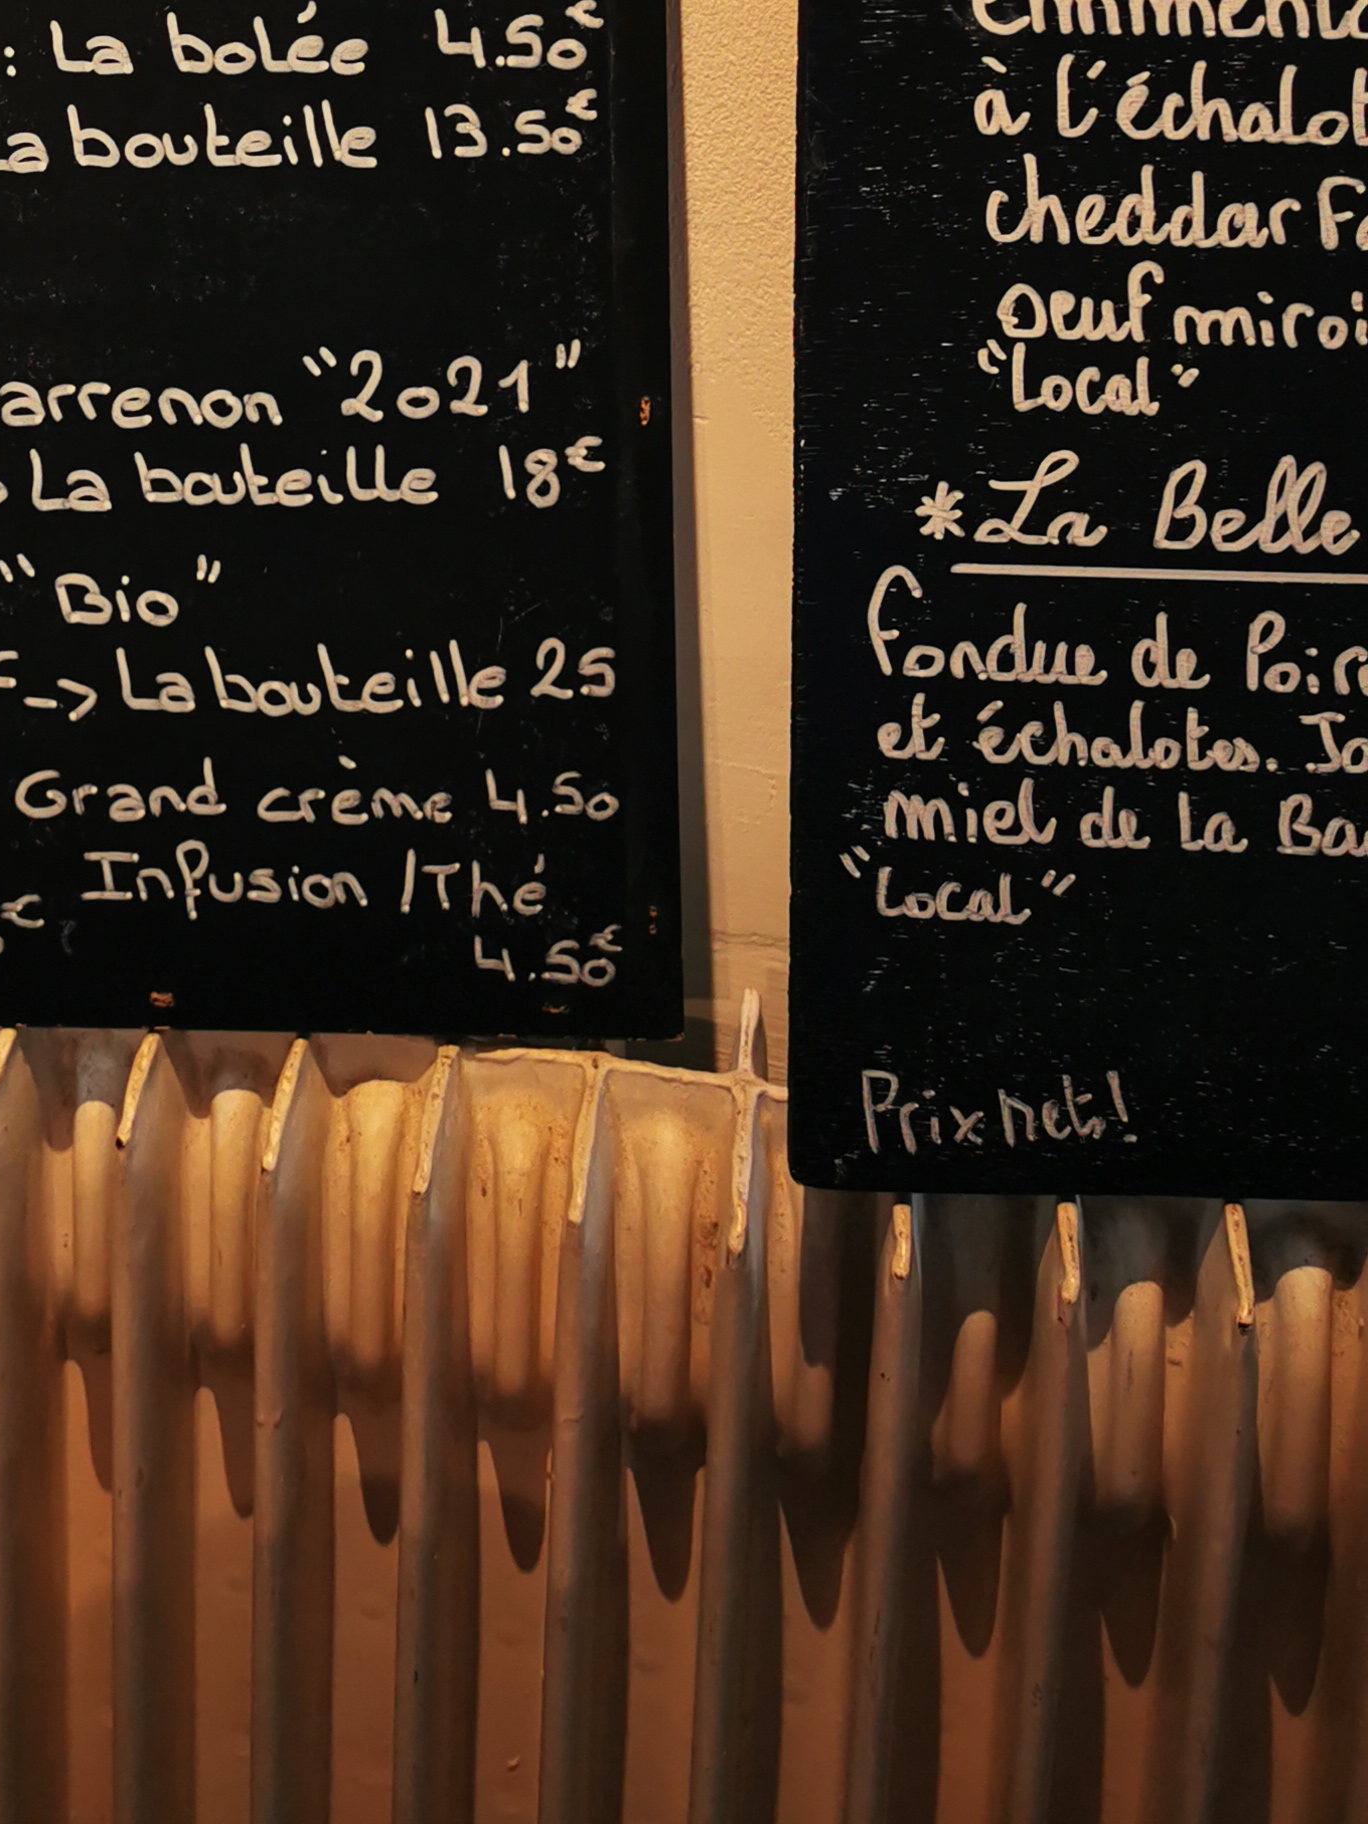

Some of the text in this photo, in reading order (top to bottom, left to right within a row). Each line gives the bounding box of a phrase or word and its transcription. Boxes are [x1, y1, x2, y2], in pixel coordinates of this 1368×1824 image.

[167, 1, 368, 75] bolée
[67, 100, 377, 168] bouteille
[974, 57, 1030, 135] à
[986, 153, 1301, 248] cheddar
[134, 443, 438, 506] bouteille
[974, 450, 1360, 555] La Belle
[205, 640, 505, 716] bouteille
[531, 638, 614, 699] 25
[1132, 612, 1210, 688] de
[1247, 611, 1368, 696] Poir
[878, 693, 945, 759] et
[16, 756, 618, 824] Grand crème 4.50
[884, 778, 1056, 844] miel
[1080, 786, 1150, 848] de
[82, 840, 367, 919] Infusion
[863, 1071, 984, 1151] Prix
